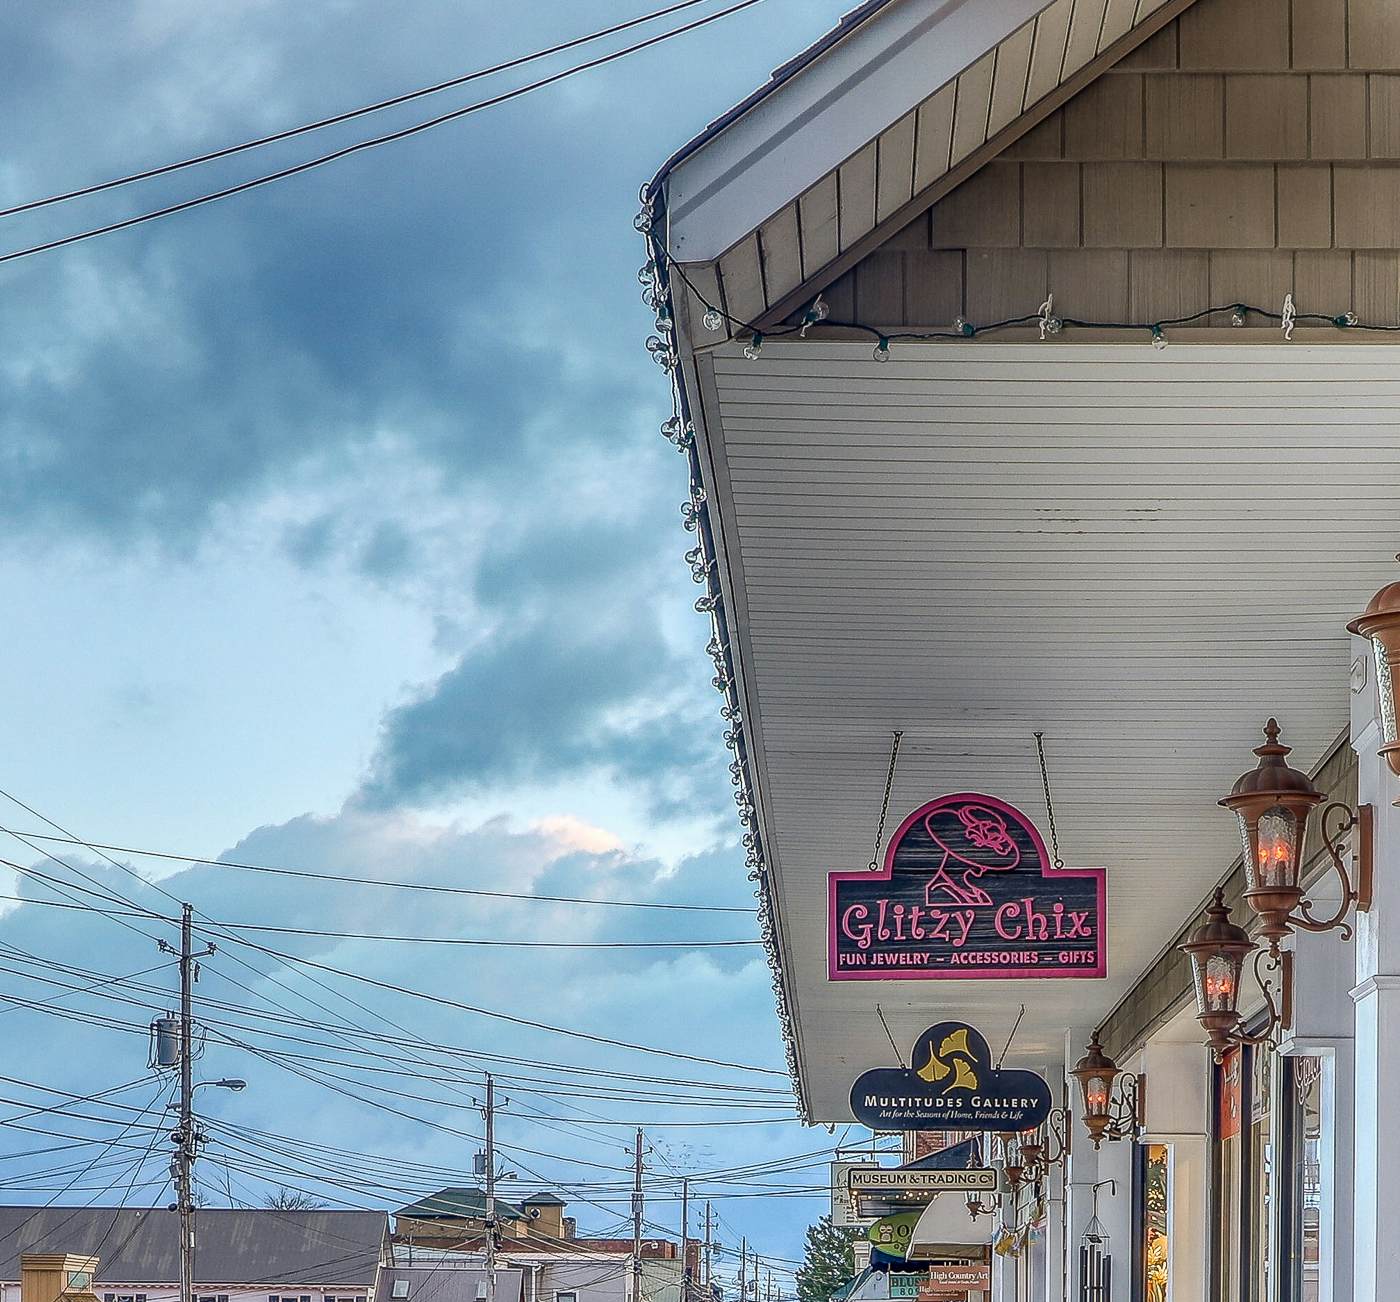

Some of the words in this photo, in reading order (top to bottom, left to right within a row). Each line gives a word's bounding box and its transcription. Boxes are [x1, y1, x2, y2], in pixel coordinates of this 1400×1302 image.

[842, 899, 975, 949] Glitzy
[994, 898, 1092, 941] Chix
[840, 953, 867, 965] FUN
[870, 953, 930, 965] JEWELRY
[950, 952, 1038, 965] ACCESSORIES
[1058, 951, 1095, 964] GIFTS
[864, 1095, 963, 1107] MULTITUDES
[971, 1096, 1039, 1108] GALLERY
[879, 1109, 892, 1118] Art
[891, 1109, 903, 1119] for
[904, 1109, 915, 1118] the
[915, 1110, 941, 1119] Seasons
[942, 1110, 951, 1119] of
[975, 1110, 1000, 1119] Friends
[1001, 1111, 1008, 1119] &
[1009, 1110, 1024, 1120] Life
[852, 1174, 907, 1184] MUSEUM
[909, 1174, 919, 1184] &
[920, 1174, 976, 1184] TRADING
[930, 1271, 947, 1281] High
[948, 1271, 976, 1281] Country
[977, 1271, 988, 1280] Art
